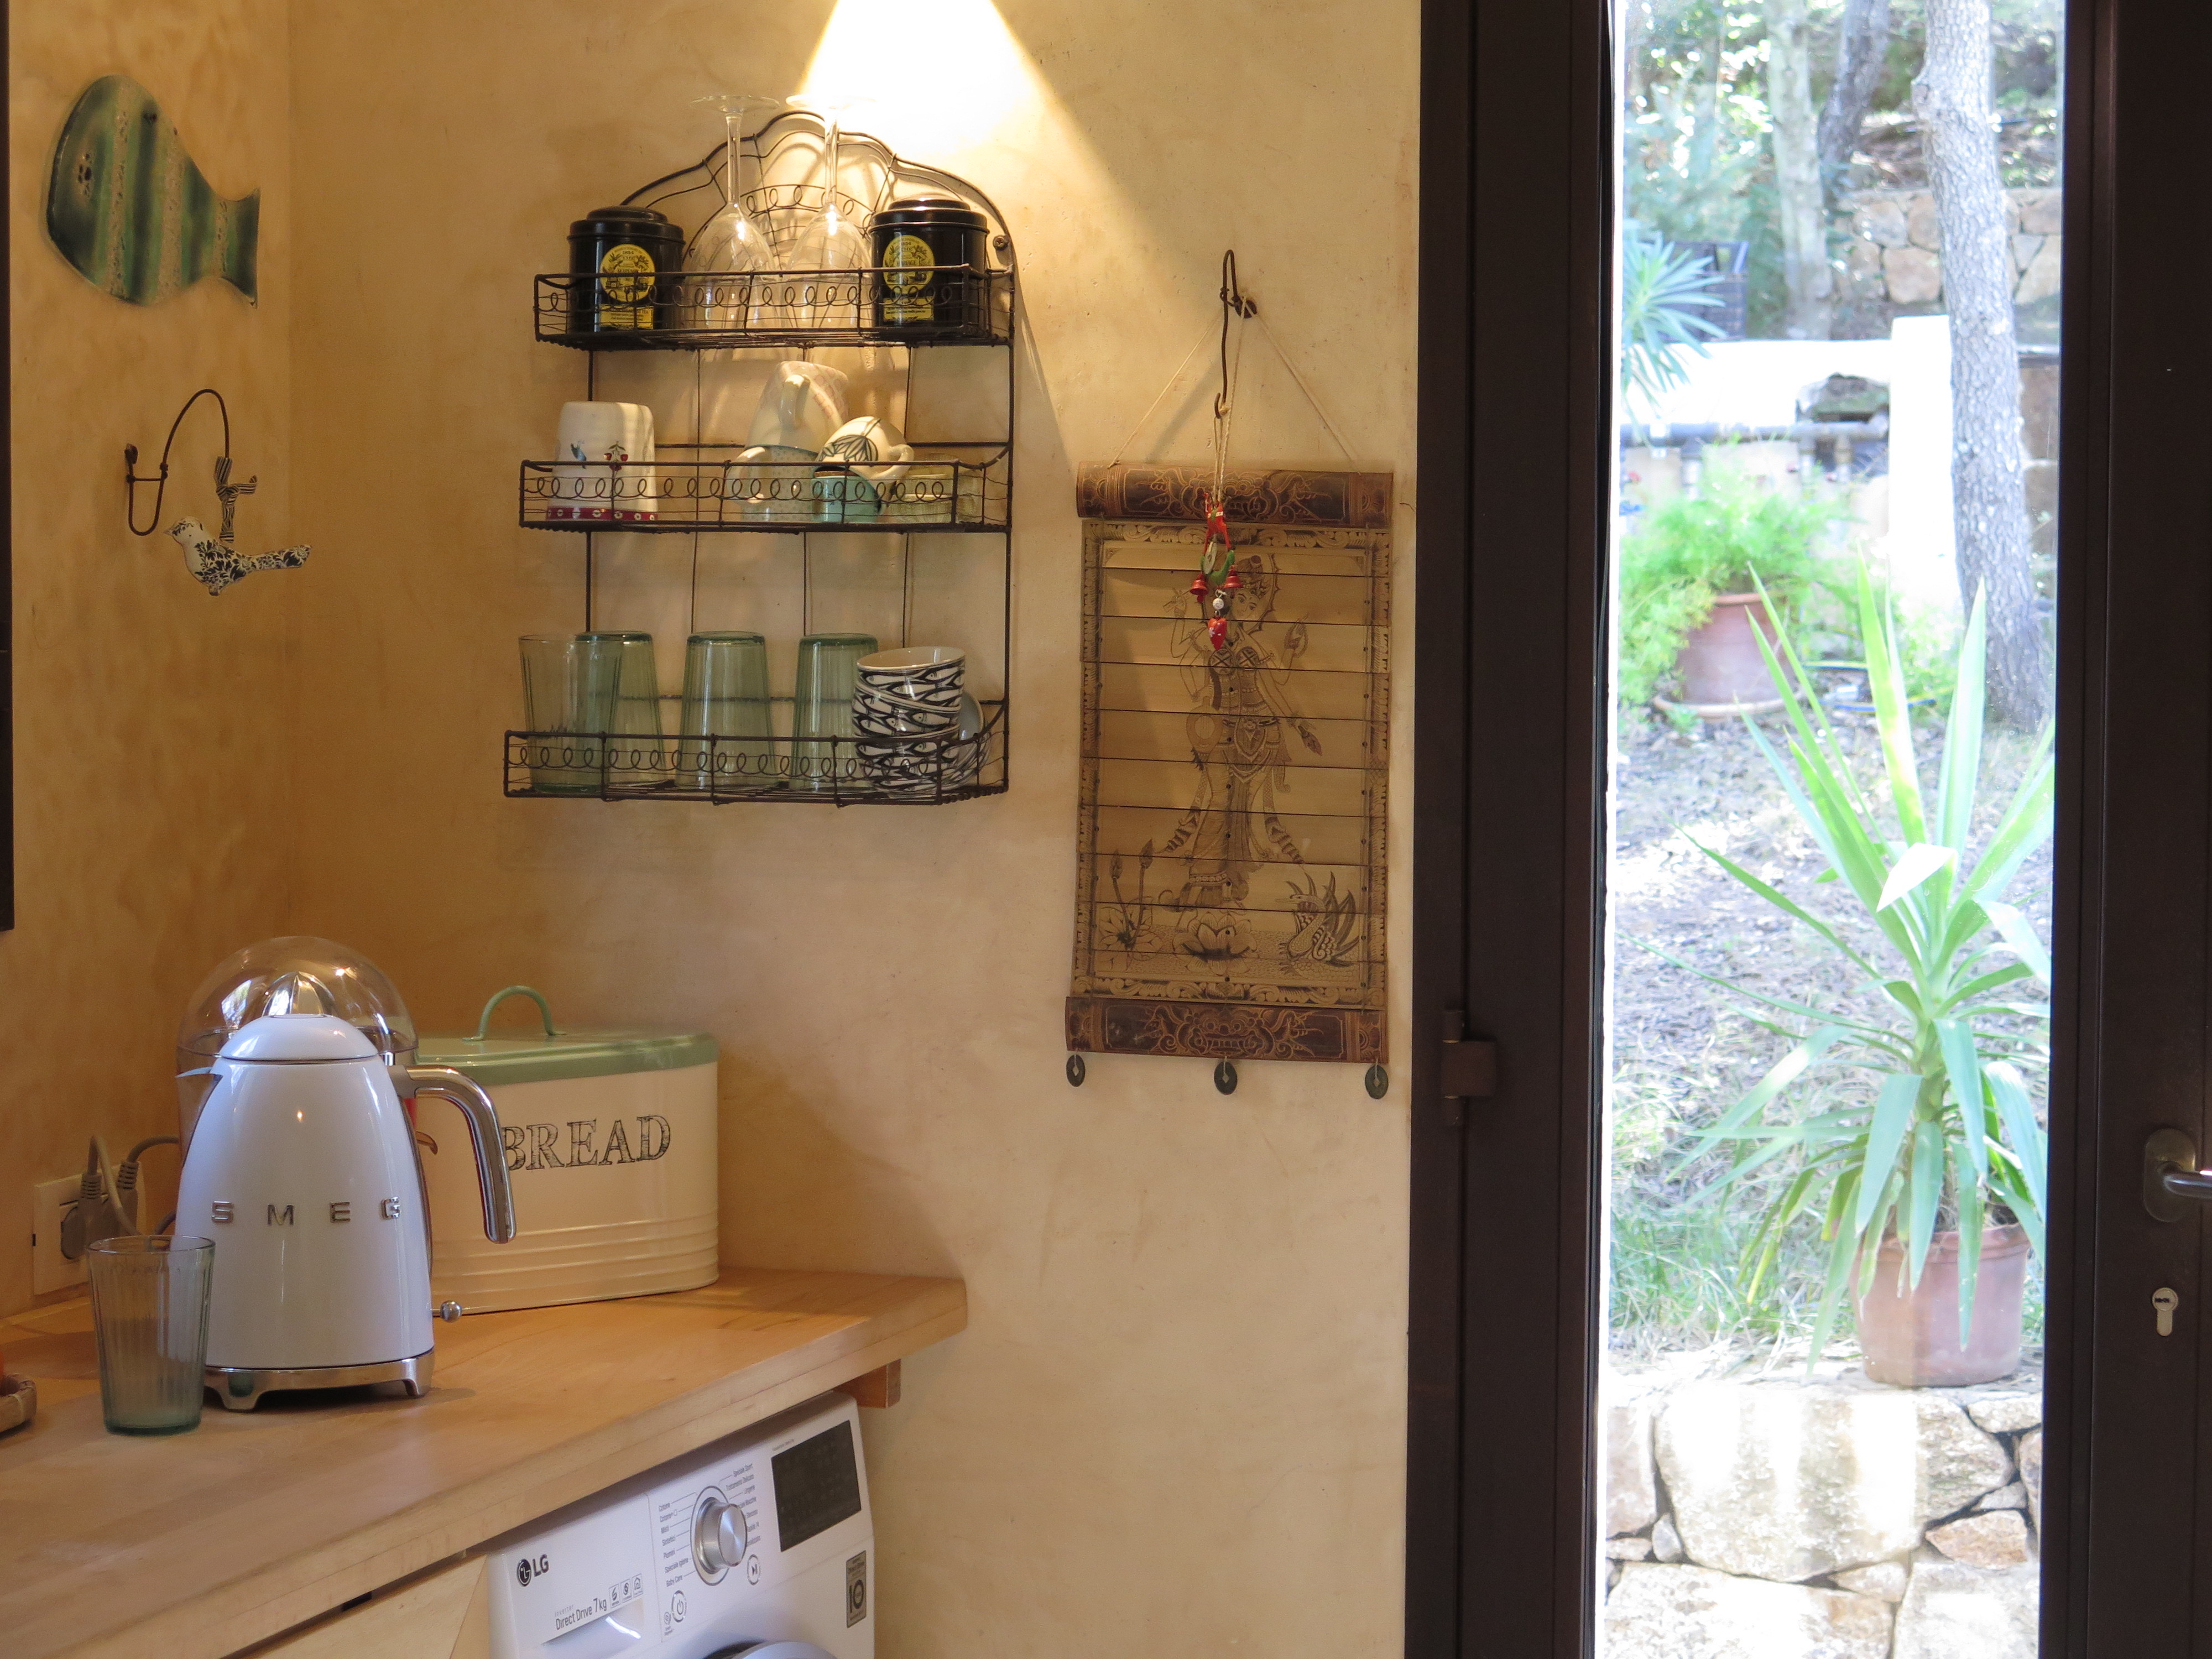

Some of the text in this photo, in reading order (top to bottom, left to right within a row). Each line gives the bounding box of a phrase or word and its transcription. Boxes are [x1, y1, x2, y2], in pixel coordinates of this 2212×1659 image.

[501, 1114, 671, 1171] BREAD
[211, 1196, 400, 1225] SMEG
[533, 1554, 549, 1577] LG
[556, 1613, 576, 1630] Direct
[576, 1605, 593, 1621] Drive
